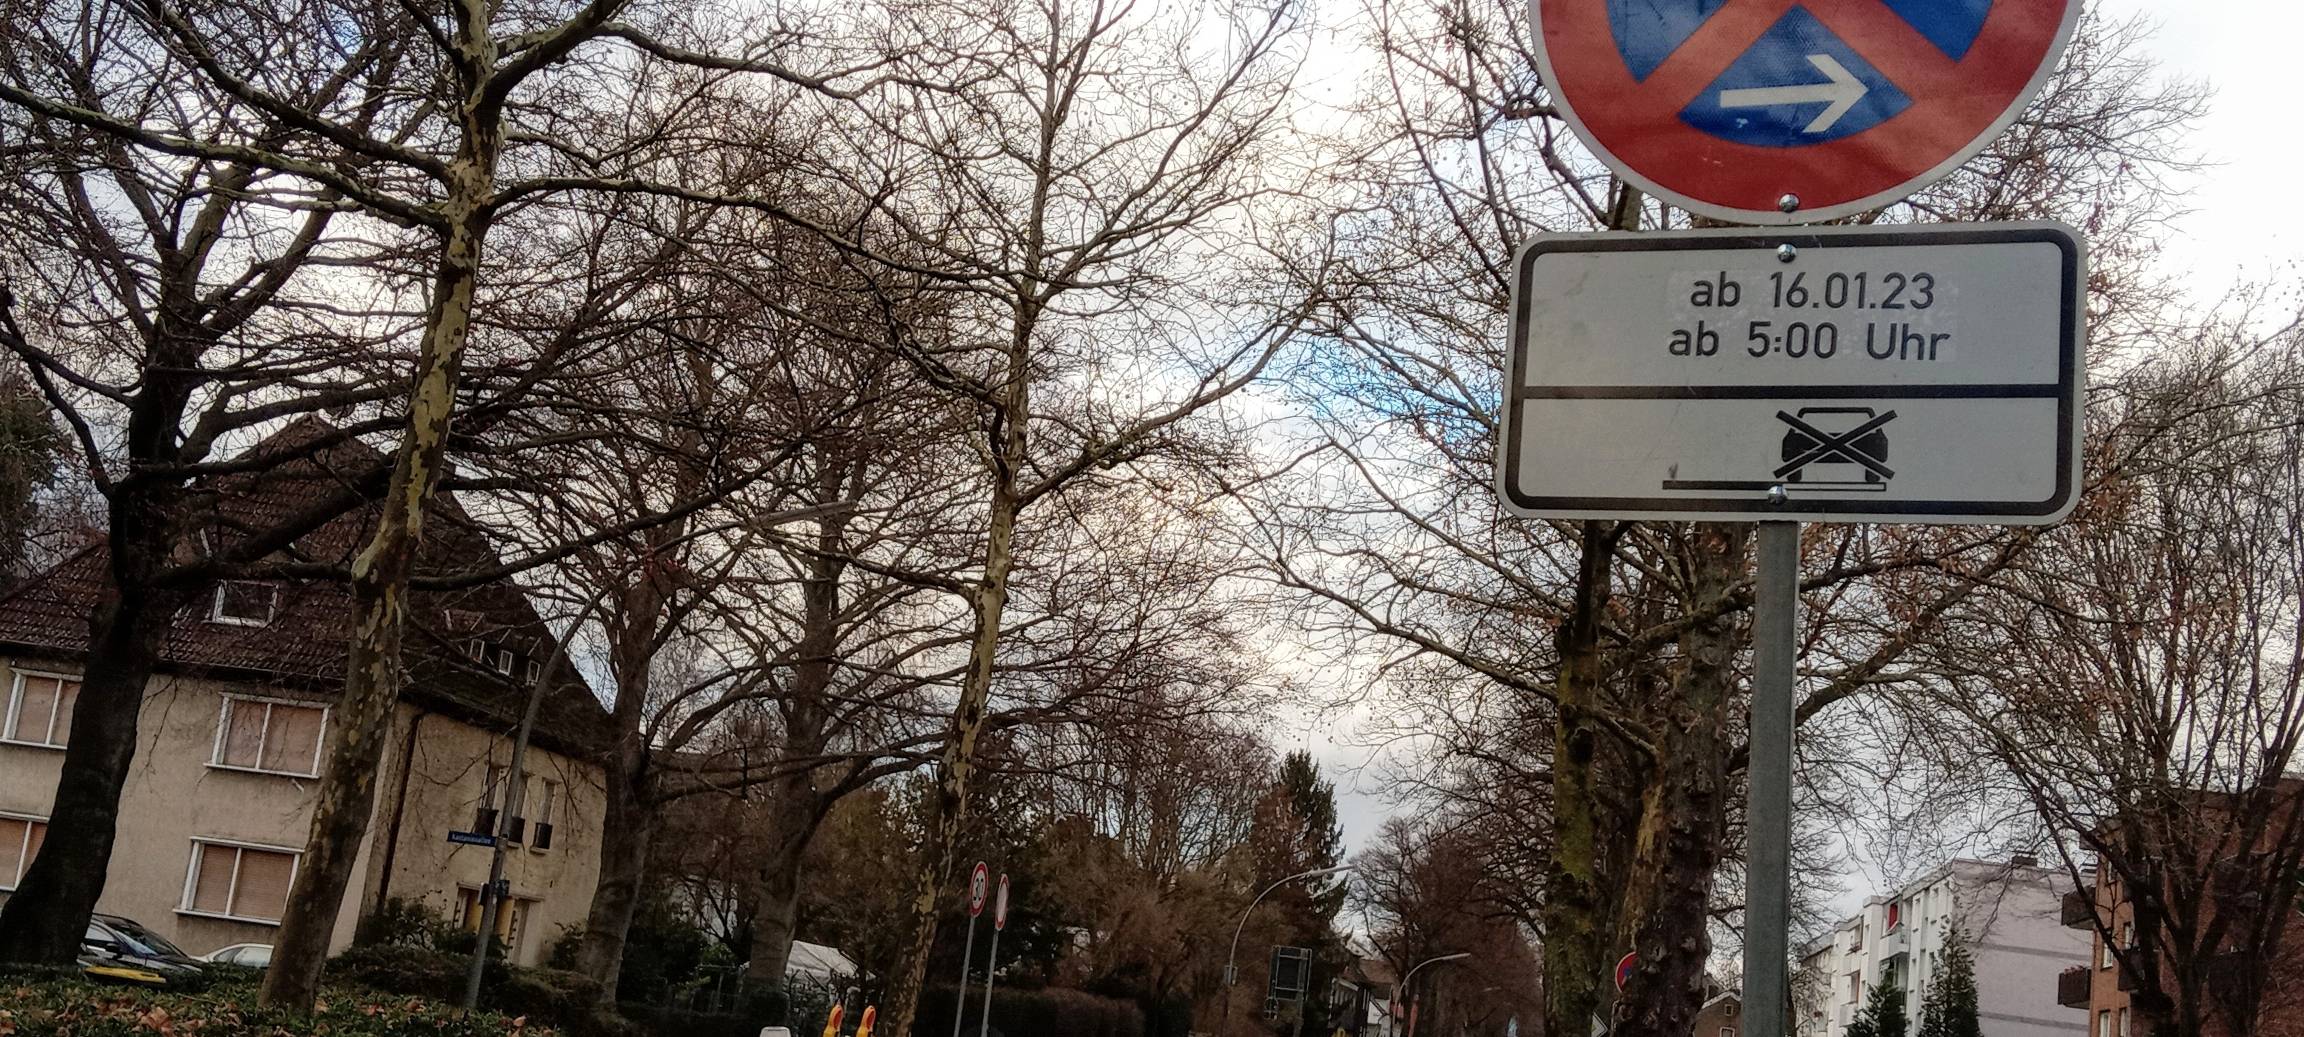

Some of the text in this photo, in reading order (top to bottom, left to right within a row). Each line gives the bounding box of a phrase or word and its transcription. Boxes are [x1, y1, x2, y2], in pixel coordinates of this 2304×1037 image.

[1690, 271, 1935, 309] ab 16.01.23
[1668, 320, 1951, 360] ab 5:00 Uhr
[973, 877, 984, 901] 30
